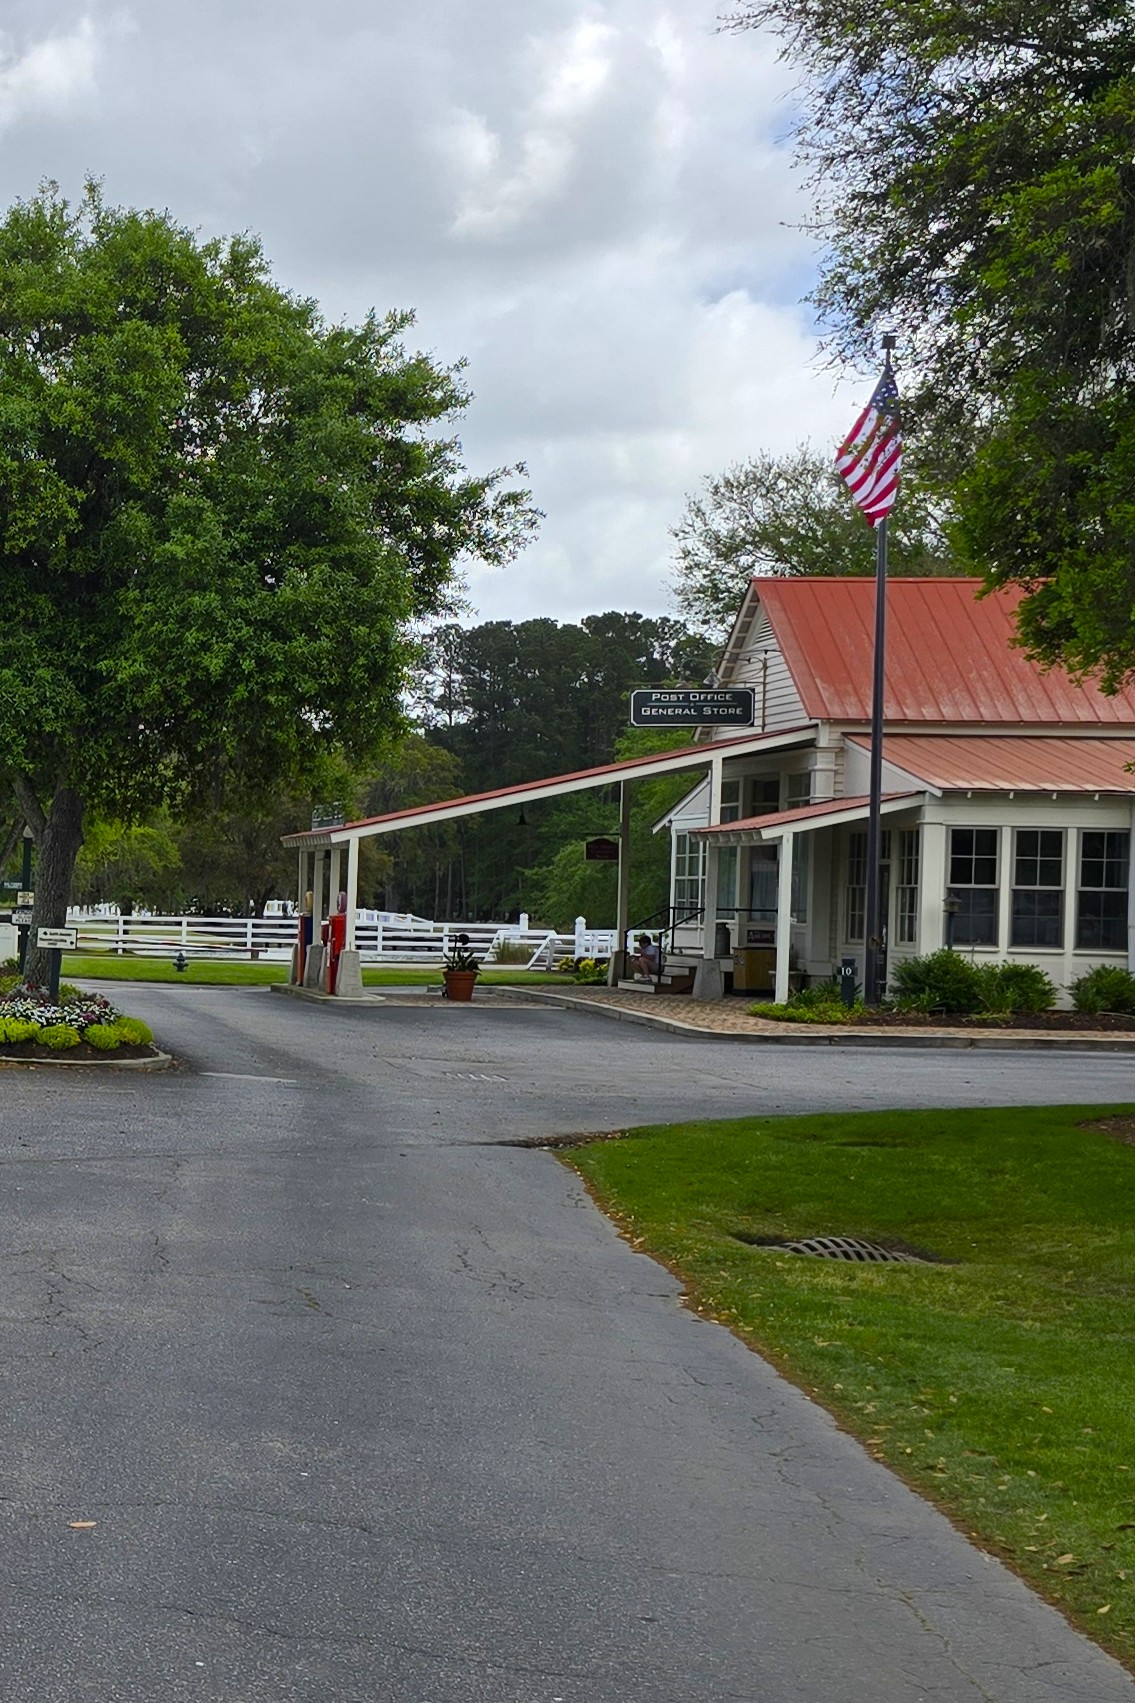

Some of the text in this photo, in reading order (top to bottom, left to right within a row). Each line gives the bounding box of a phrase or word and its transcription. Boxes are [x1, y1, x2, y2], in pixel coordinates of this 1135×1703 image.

[651, 693, 733, 701] POST OFFICE
[641, 706, 743, 716] GENERAL STORE
[841, 968, 852, 976] 10
